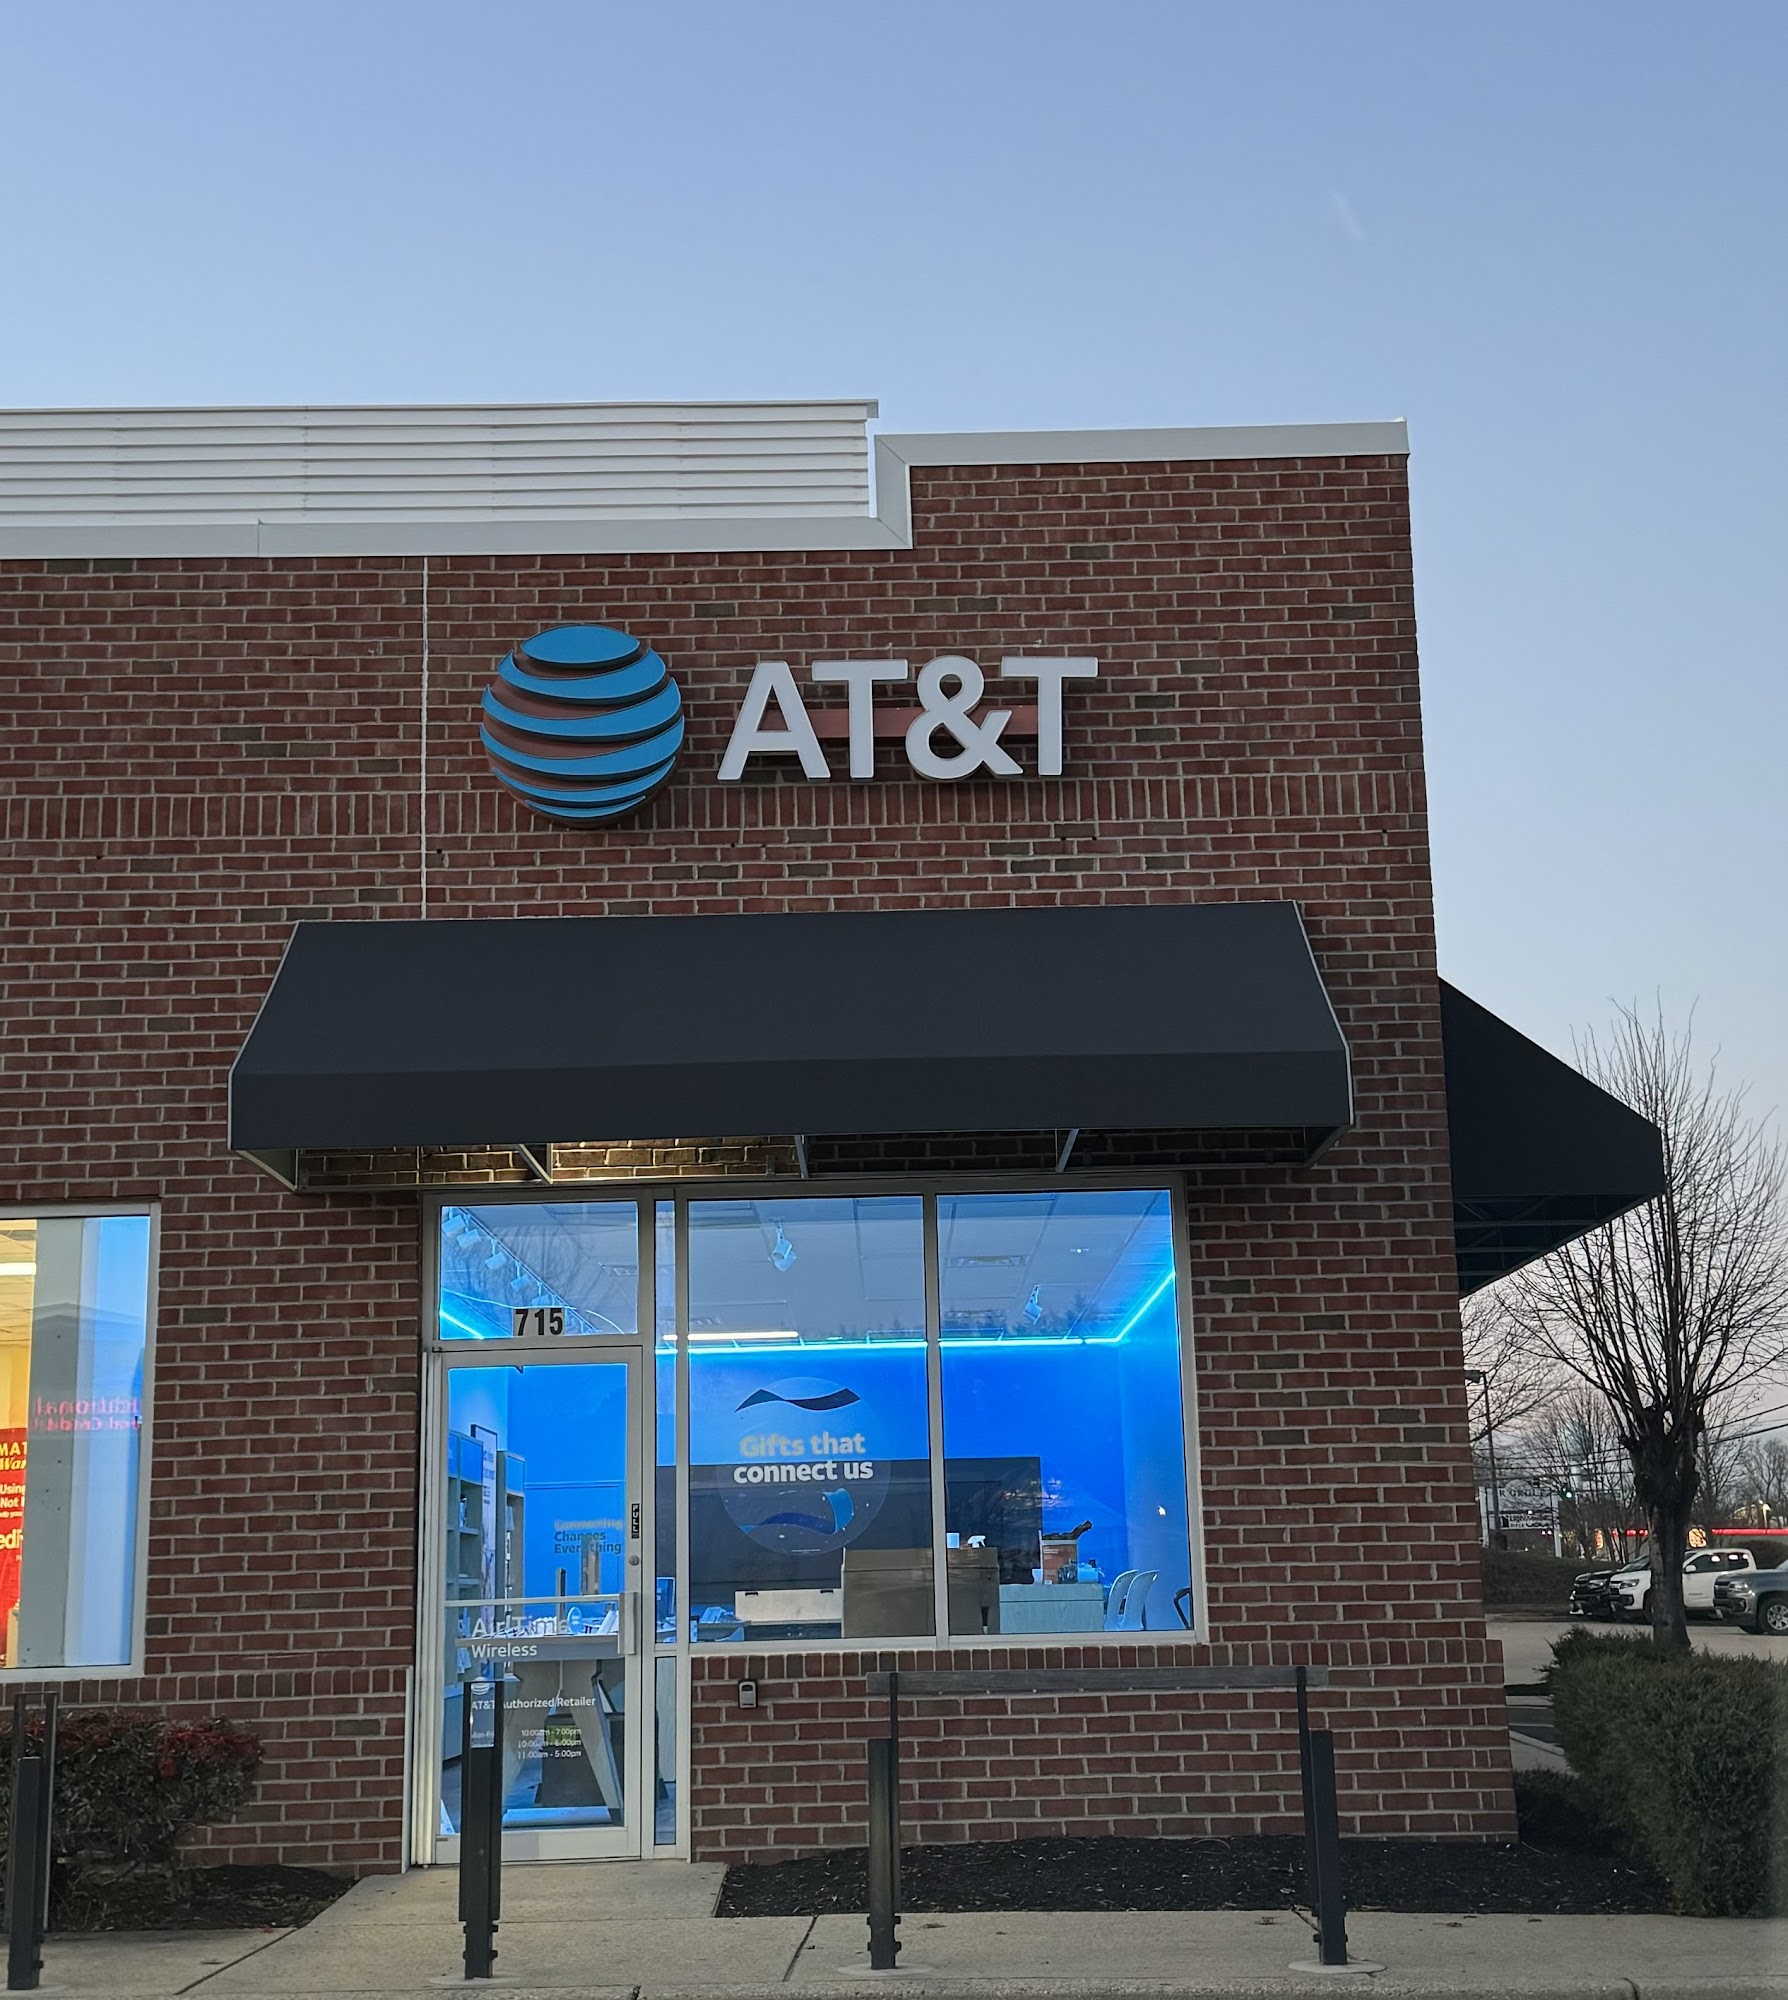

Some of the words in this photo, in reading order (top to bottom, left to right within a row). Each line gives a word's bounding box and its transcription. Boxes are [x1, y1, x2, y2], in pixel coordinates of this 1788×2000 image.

[717, 655, 1099, 781] AT&T
[515, 1308, 563, 1336] 715
[739, 1432, 805, 1458] Gifts
[810, 1431, 866, 1455] that
[733, 1460, 838, 1484] connect
[843, 1461, 874, 1480] us
[554, 1542, 622, 1555] Everthing
[472, 1643, 538, 1659] Wireless
[471, 1700, 496, 1711] AT&T
[557, 1697, 596, 1707] Retailer
[554, 1750, 582, 1758] 5:00pm
